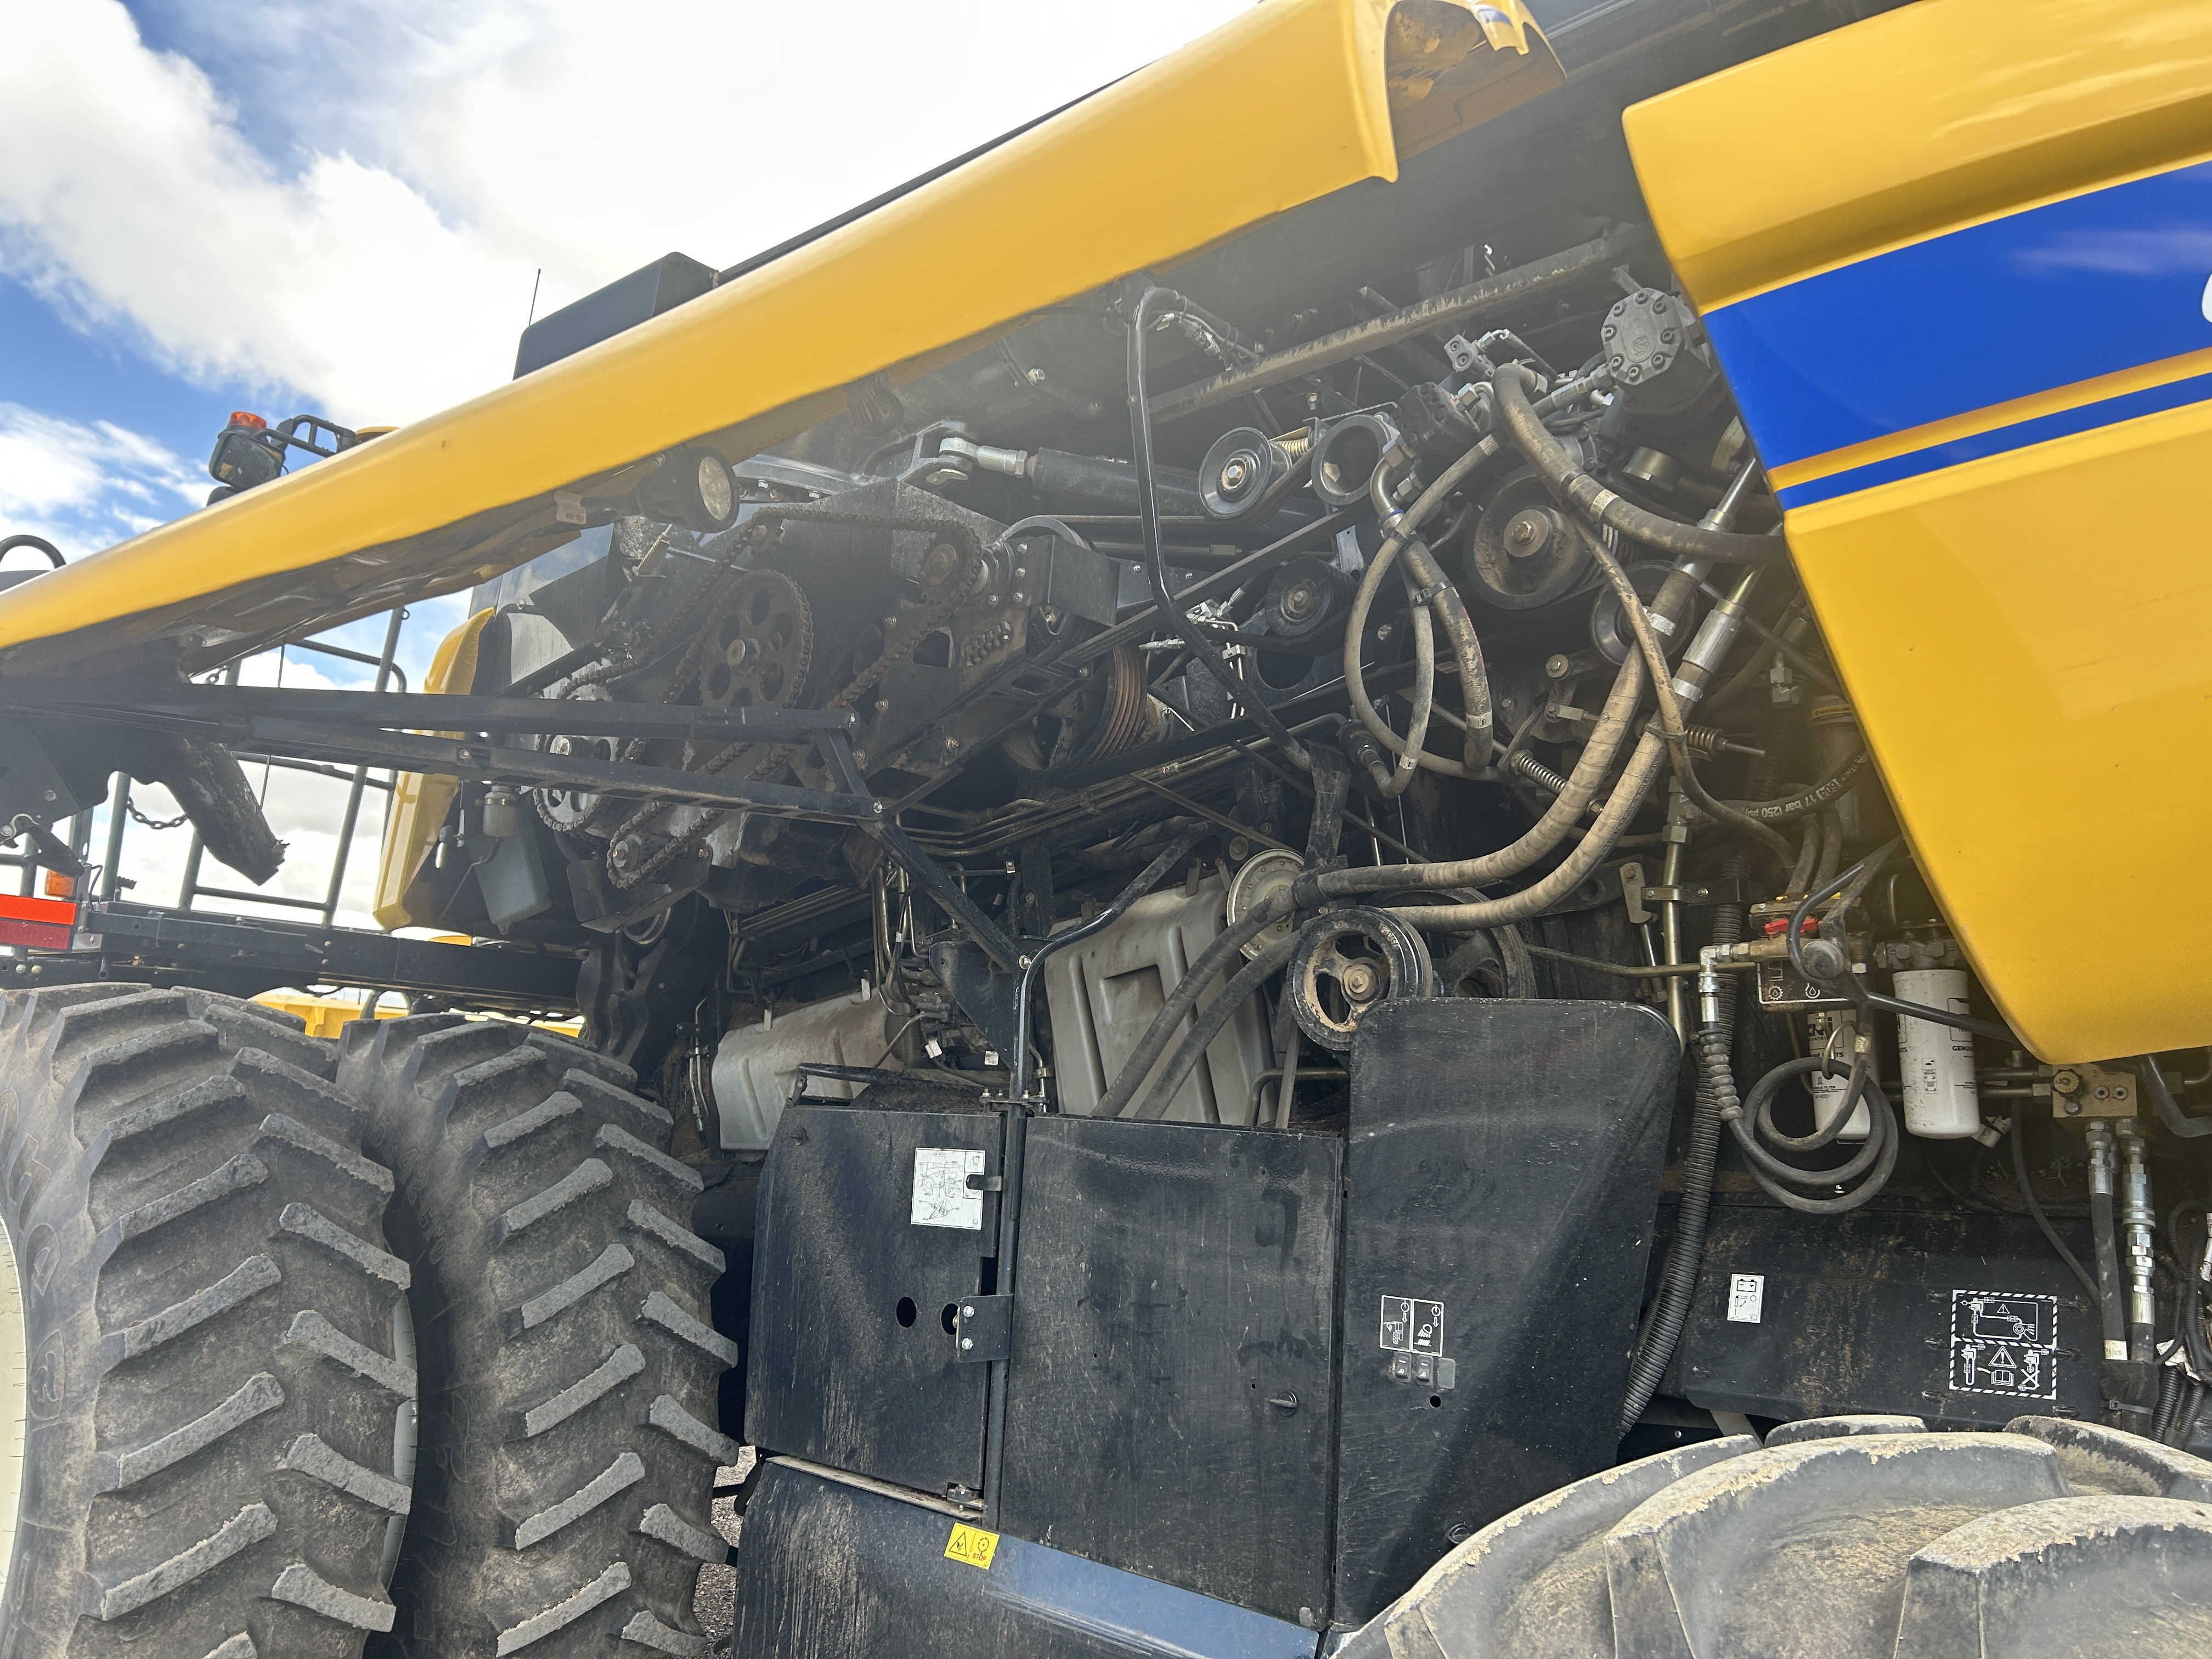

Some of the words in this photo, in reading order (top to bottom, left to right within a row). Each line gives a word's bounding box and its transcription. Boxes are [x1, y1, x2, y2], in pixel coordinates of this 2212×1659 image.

[1818, 780, 1838, 798] 604
[1785, 799, 1804, 812] bar
[1805, 794, 1817, 807] 17
[1761, 805, 1782, 817] (250
[973, 1553, 986, 1561] STOP
